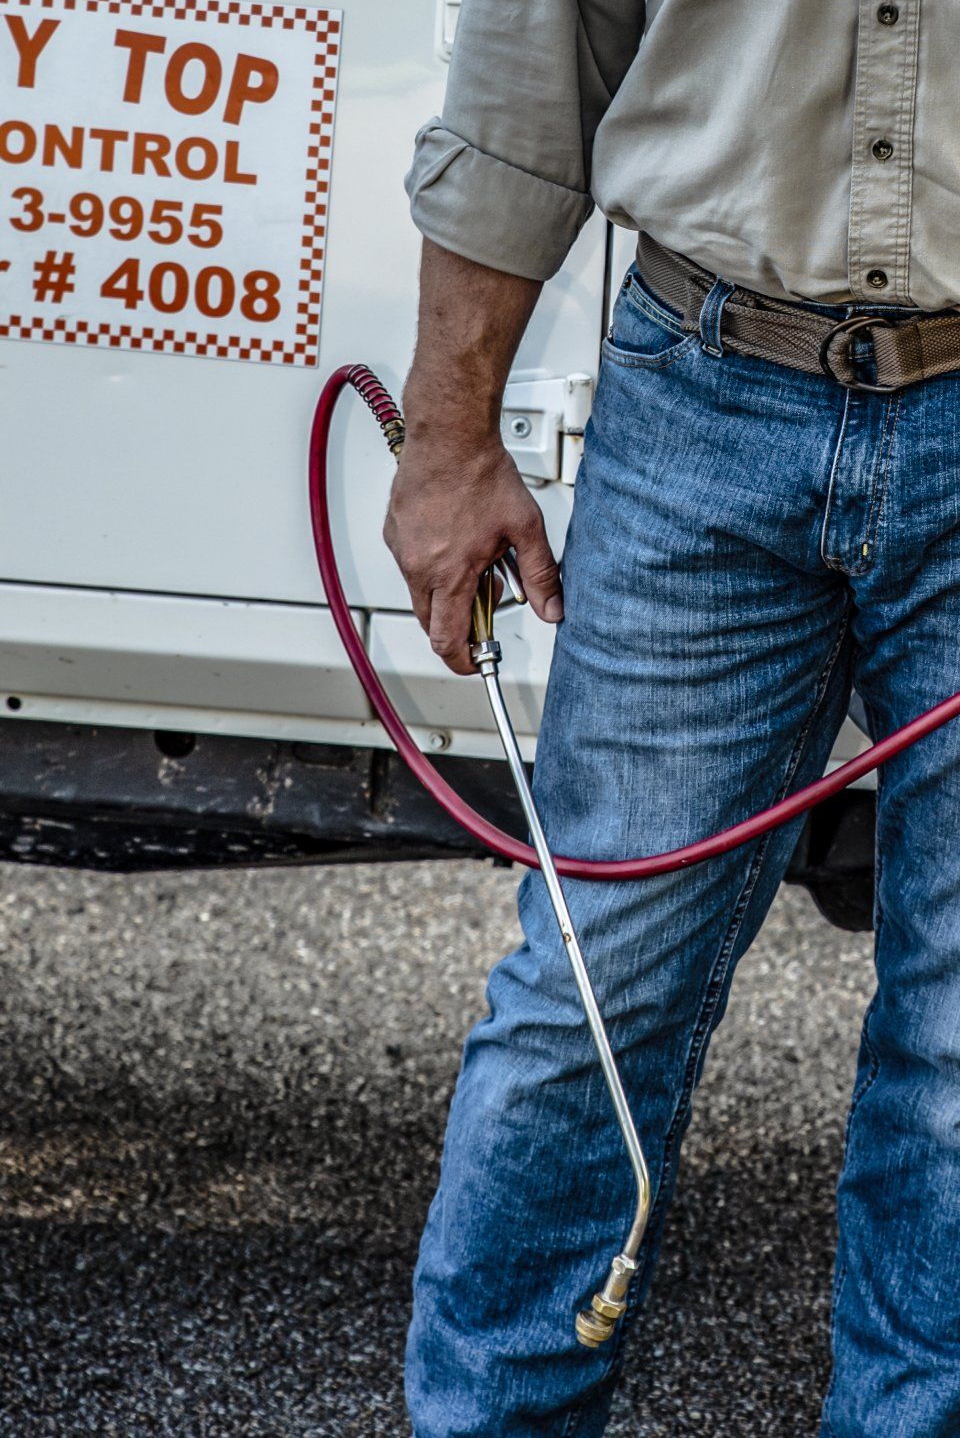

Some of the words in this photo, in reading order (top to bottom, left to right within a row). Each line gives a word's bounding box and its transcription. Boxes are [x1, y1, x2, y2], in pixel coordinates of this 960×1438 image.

[4, 14, 61, 88] Y
[114, 28, 279, 125] TOP
[0, 120, 257, 187] ONTROL
[9, 187, 223, 248] 3-9955
[33, 250, 76, 303] #
[100, 258, 281, 323] 4008
